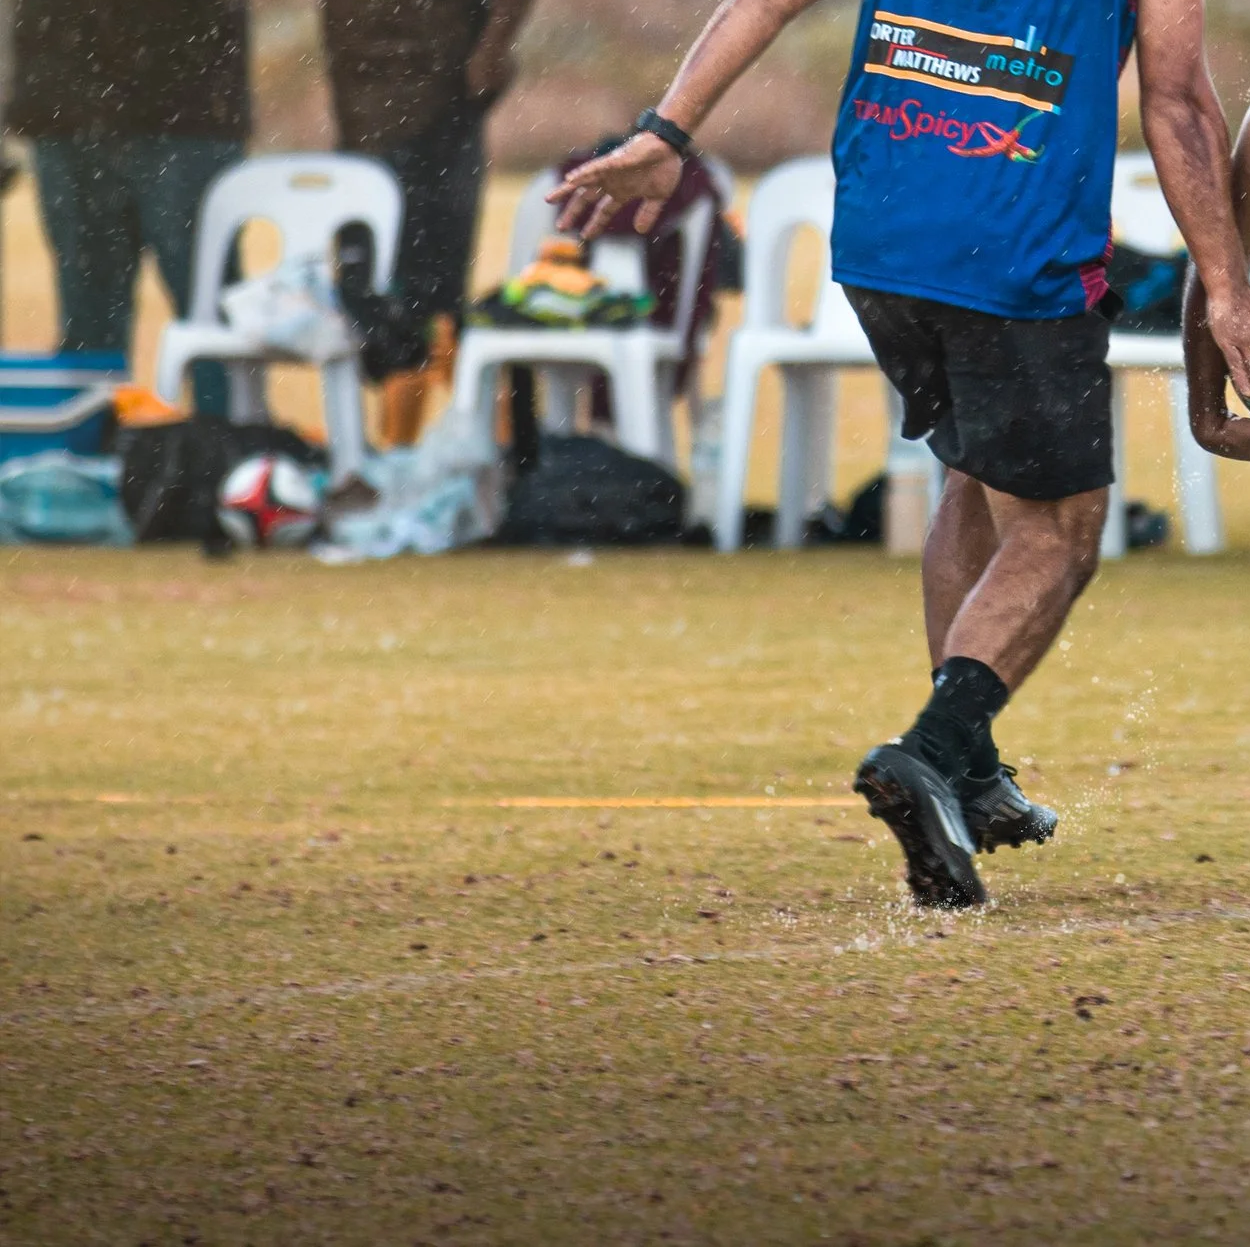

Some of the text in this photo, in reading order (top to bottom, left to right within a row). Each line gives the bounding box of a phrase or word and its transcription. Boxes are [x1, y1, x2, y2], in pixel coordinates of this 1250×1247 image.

[869, 22, 917, 47] ORTER
[892, 49, 982, 84] MATTHEWS
[985, 52, 1064, 87] metro
